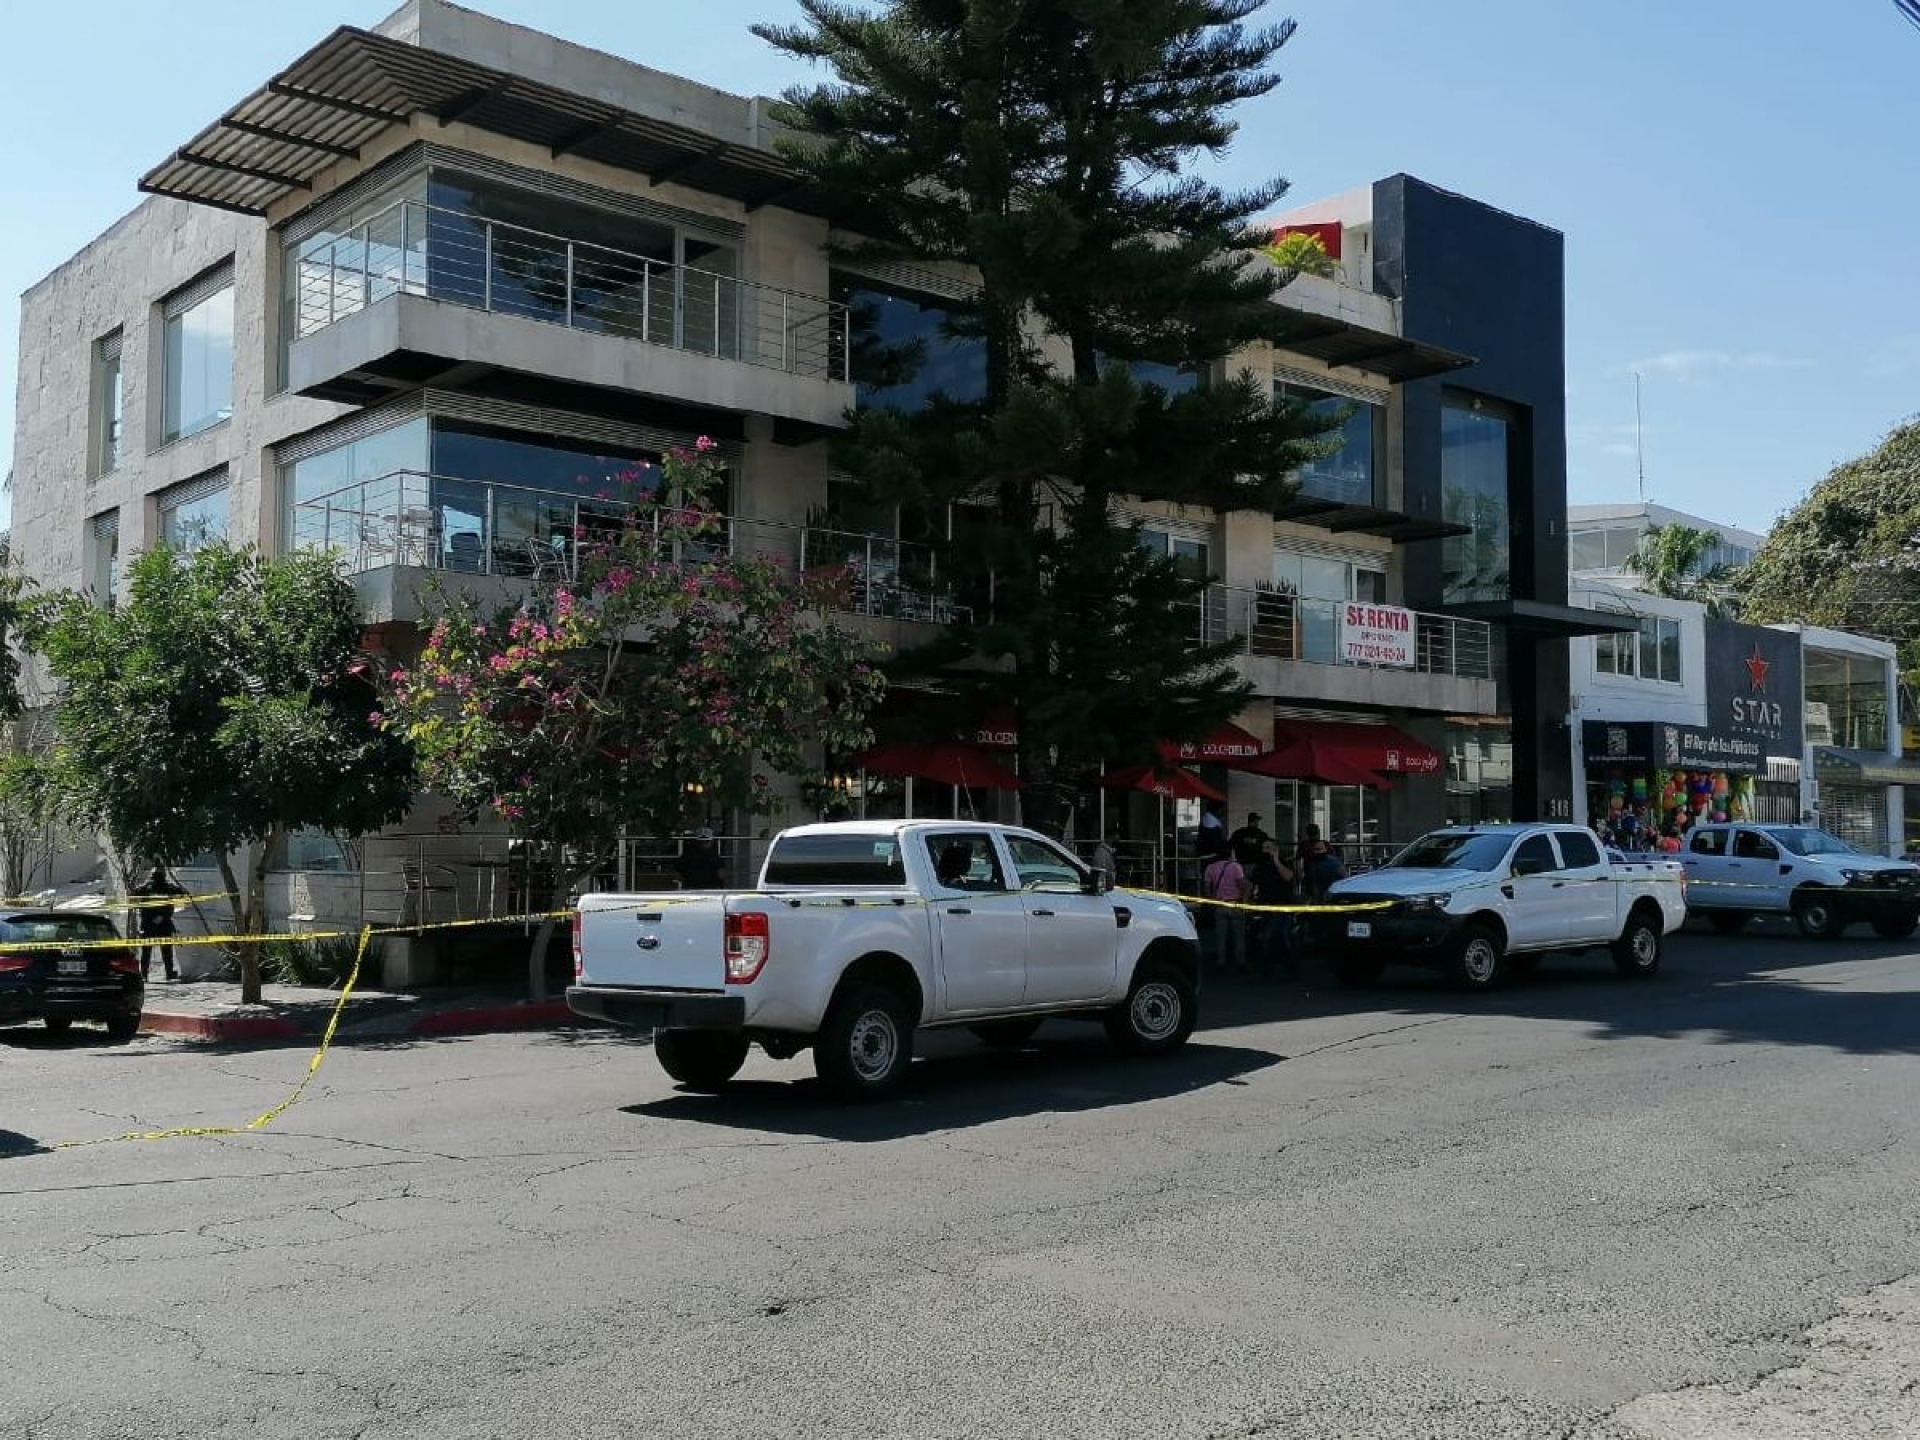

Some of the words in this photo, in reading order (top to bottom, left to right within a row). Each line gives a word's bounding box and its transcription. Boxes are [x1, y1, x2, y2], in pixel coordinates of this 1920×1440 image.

[1347, 605, 1365, 626] SE
[1367, 608, 1409, 632] RENTA
[1732, 697, 1781, 726] STAR
[1693, 735, 1707, 754] Rey
[1708, 736, 1718, 752] de
